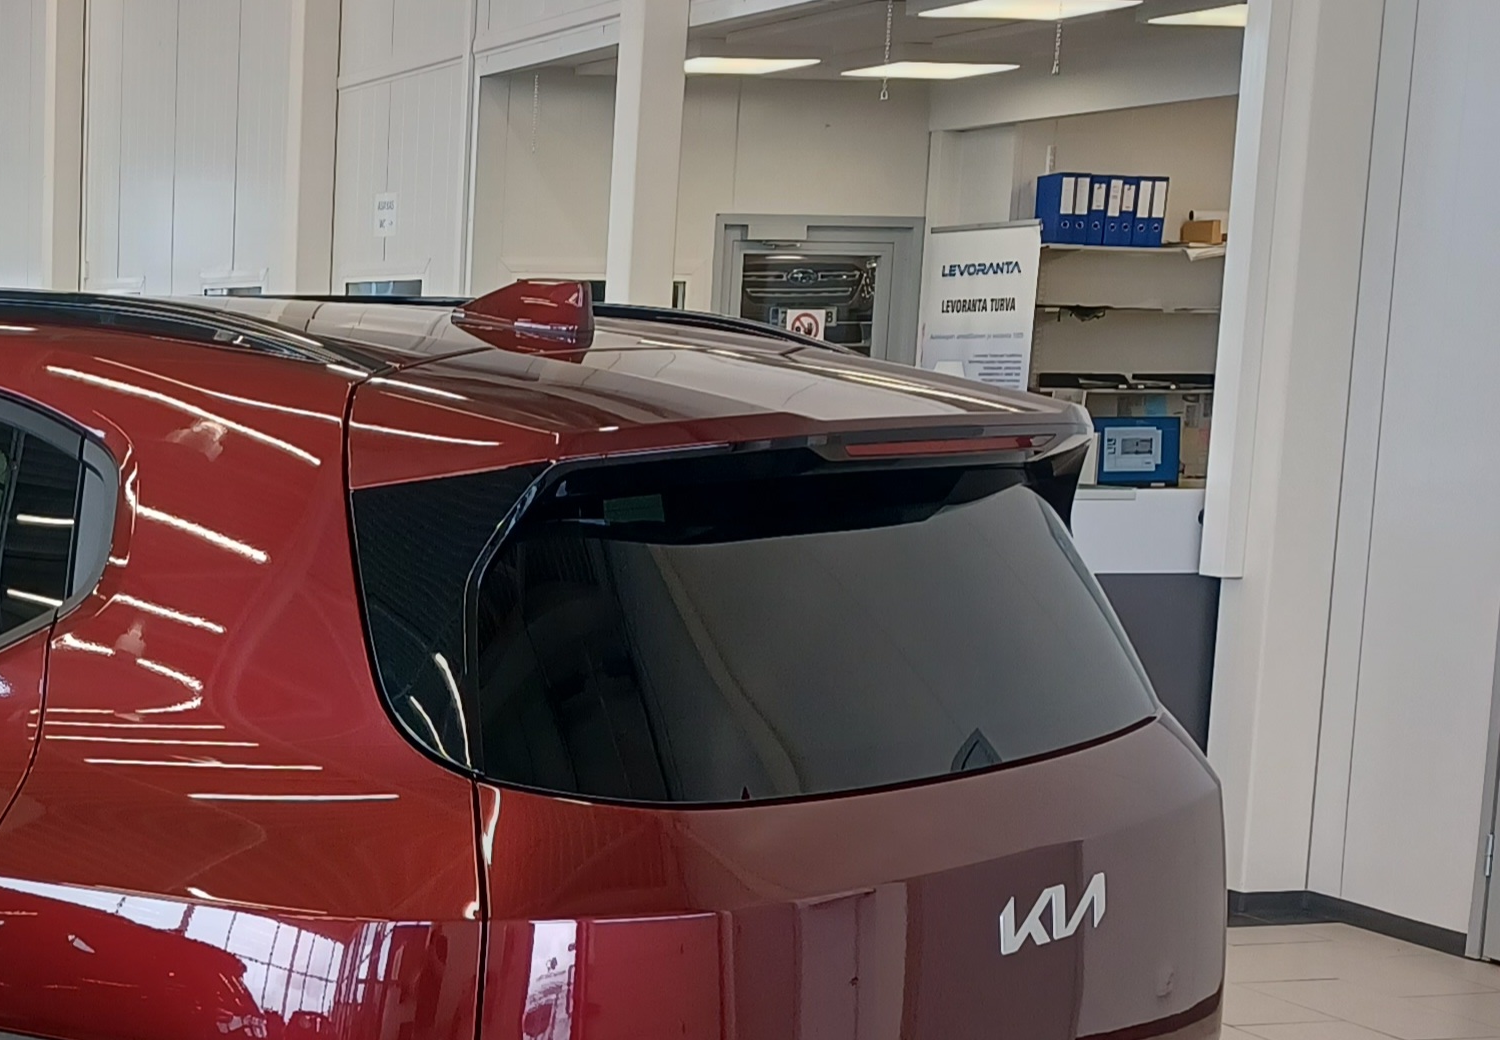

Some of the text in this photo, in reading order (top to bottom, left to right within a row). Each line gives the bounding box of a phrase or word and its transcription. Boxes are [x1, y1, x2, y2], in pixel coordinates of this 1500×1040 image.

[941, 261, 1022, 278] LEVORANTA
[941, 297, 1016, 314] LEVORANTA TURVA
[998, 872, 1107, 956] KIA
